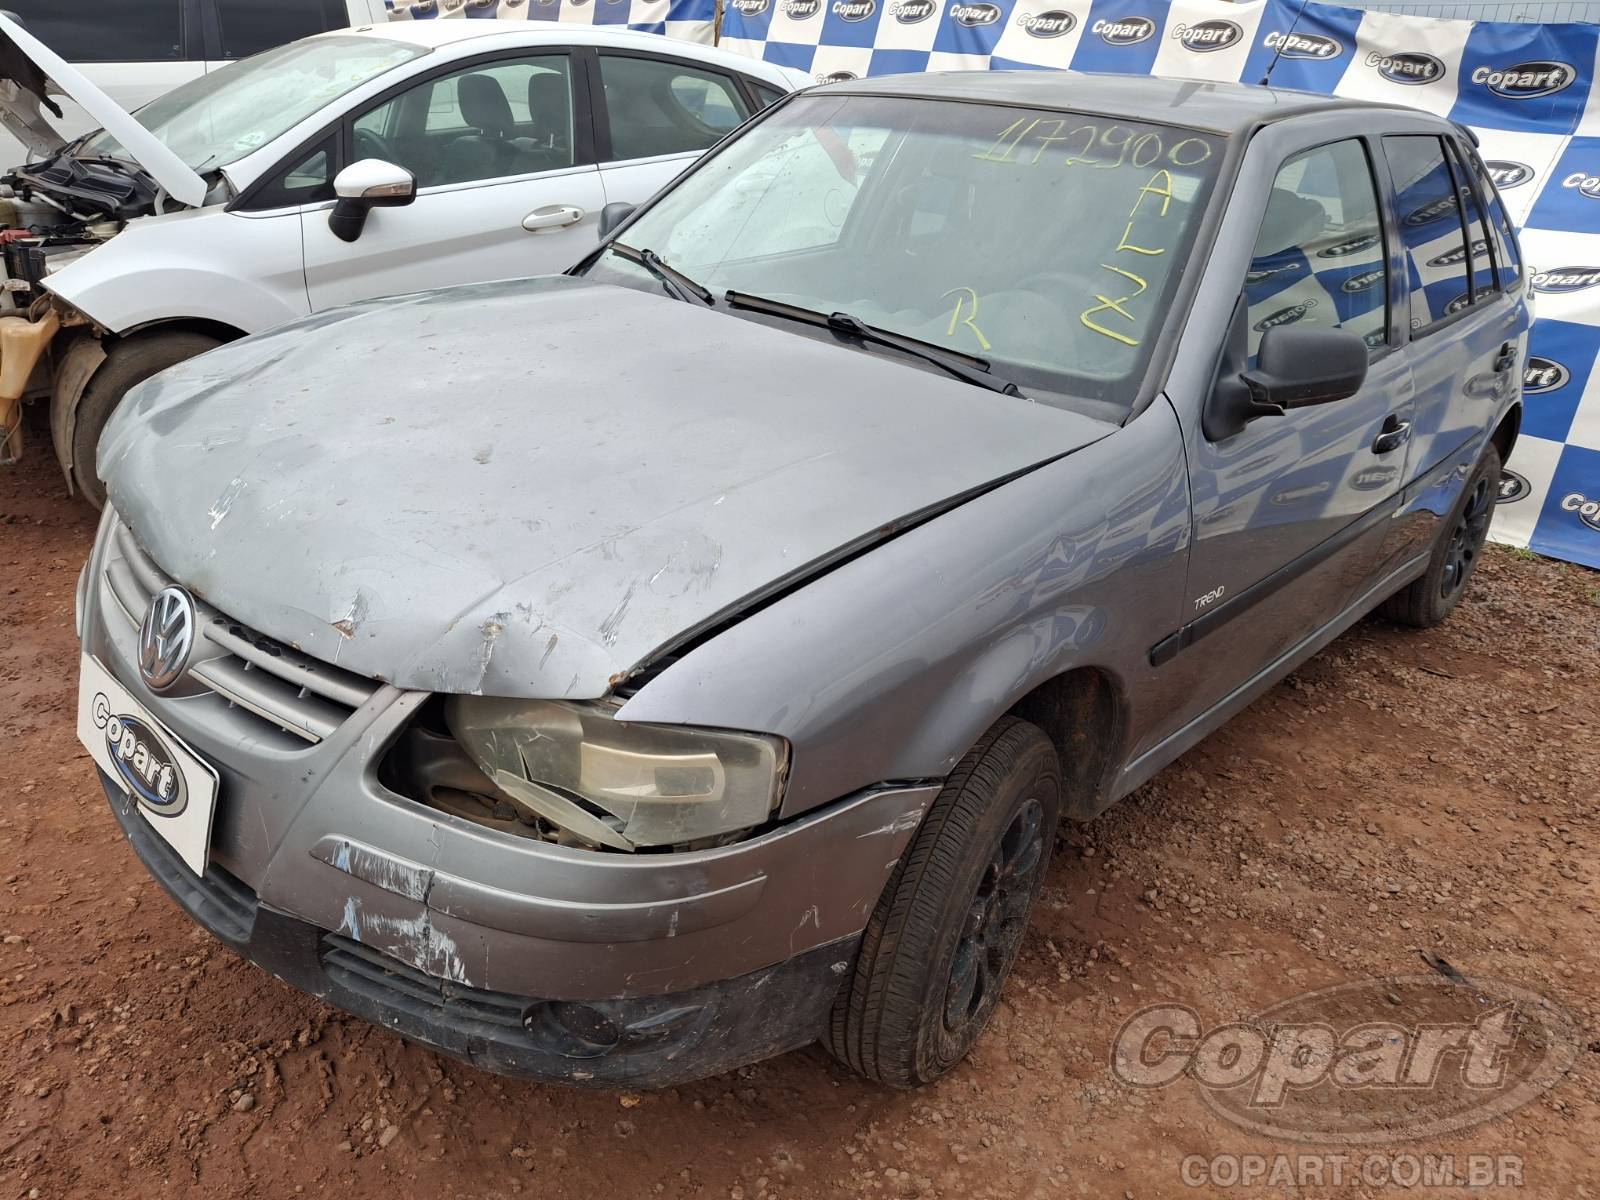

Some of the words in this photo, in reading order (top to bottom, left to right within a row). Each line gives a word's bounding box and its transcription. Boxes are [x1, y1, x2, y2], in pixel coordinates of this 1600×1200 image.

[781, 0, 816, 13] Copart
[832, 1, 871, 15] Copart
[888, 2, 930, 17] Copart
[950, 4, 994, 21] Copart
[1016, 12, 1068, 32] Copart
[1091, 19, 1148, 39] Copart
[1171, 23, 1234, 44] Copart
[1263, 31, 1333, 56] Copart
[1364, 50, 1435, 78] Copart
[1471, 66, 1563, 90] Copart
[971, 117, 1212, 169] 1172900
[1194, 585, 1225, 611] TREND
[91, 691, 176, 803] Copart
